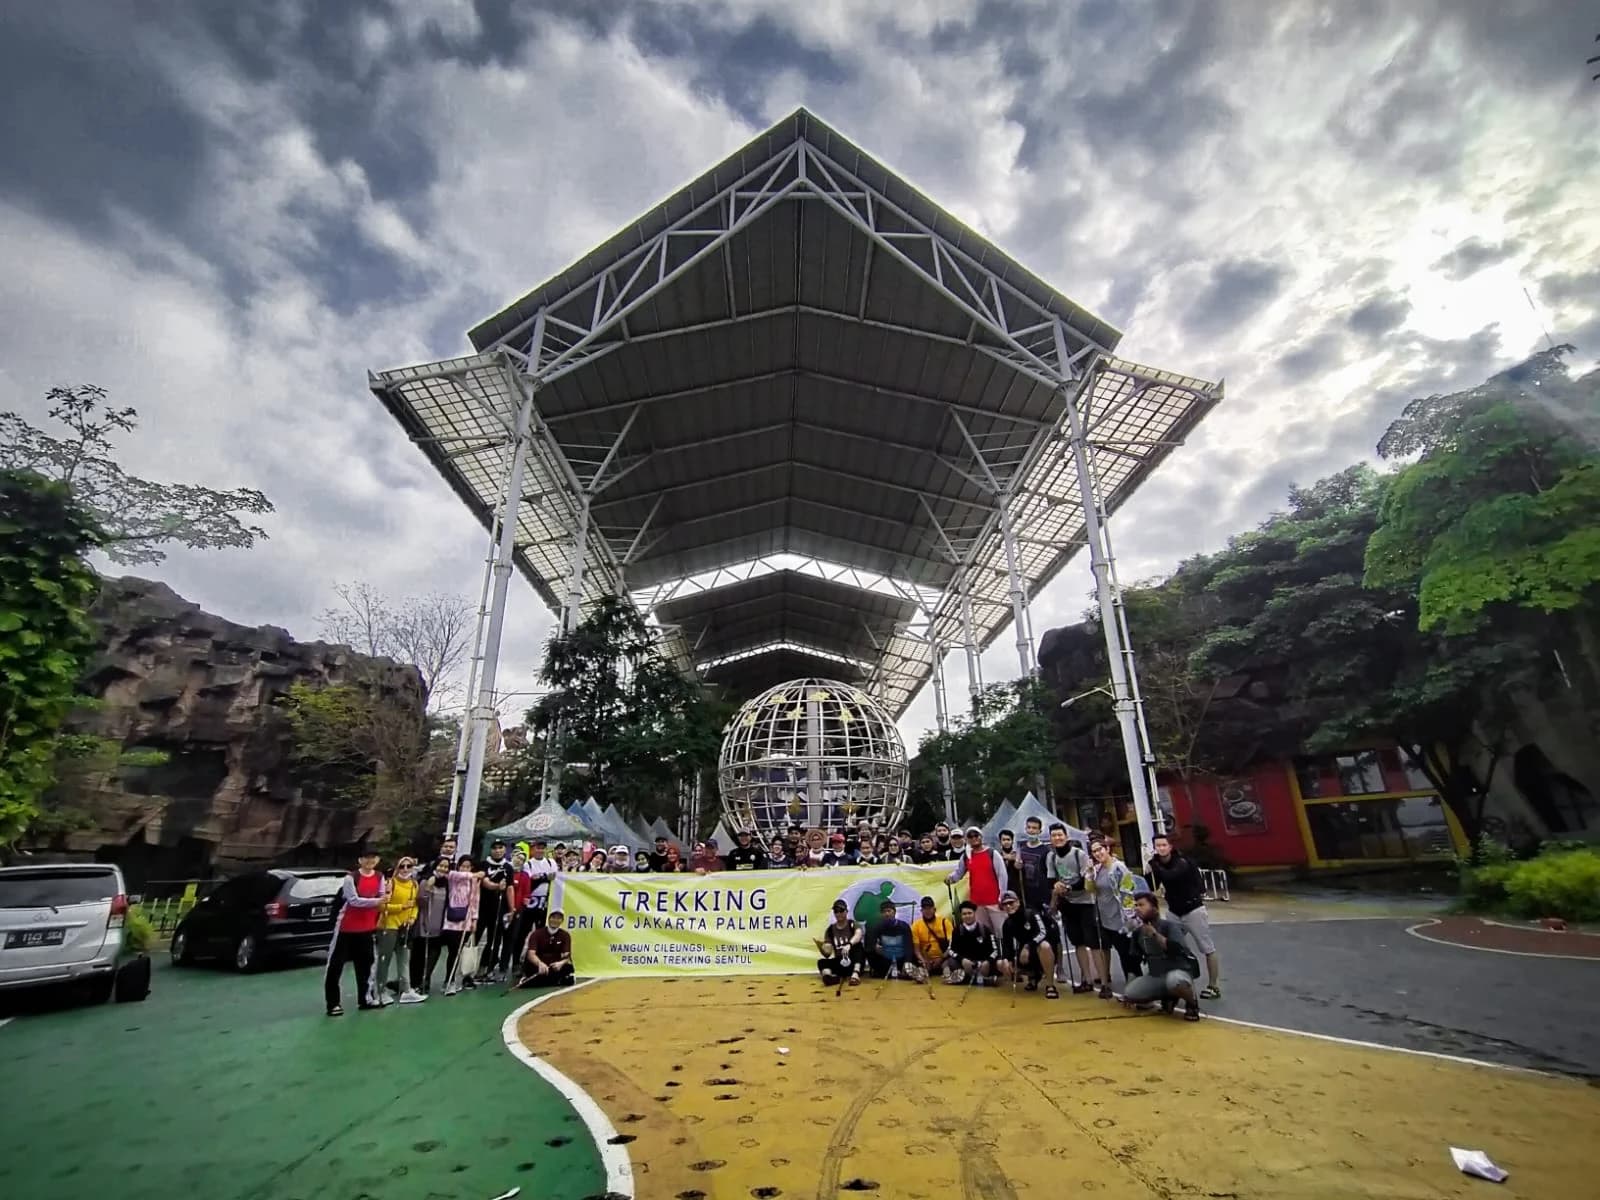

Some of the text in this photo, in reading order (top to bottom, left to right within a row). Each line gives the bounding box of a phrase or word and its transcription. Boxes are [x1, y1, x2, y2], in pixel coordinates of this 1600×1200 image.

[618, 889, 766, 912] TREKKING
[567, 914, 808, 930] BRI KC JAKARTA PALMERAH
[610, 943, 650, 952] WANGUN
[654, 943, 705, 952] CILEUNGSI
[715, 943, 738, 952] LEWI
[741, 944, 767, 952] HEJO
[621, 954, 752, 965] PESONA TREKKING SENTUL
